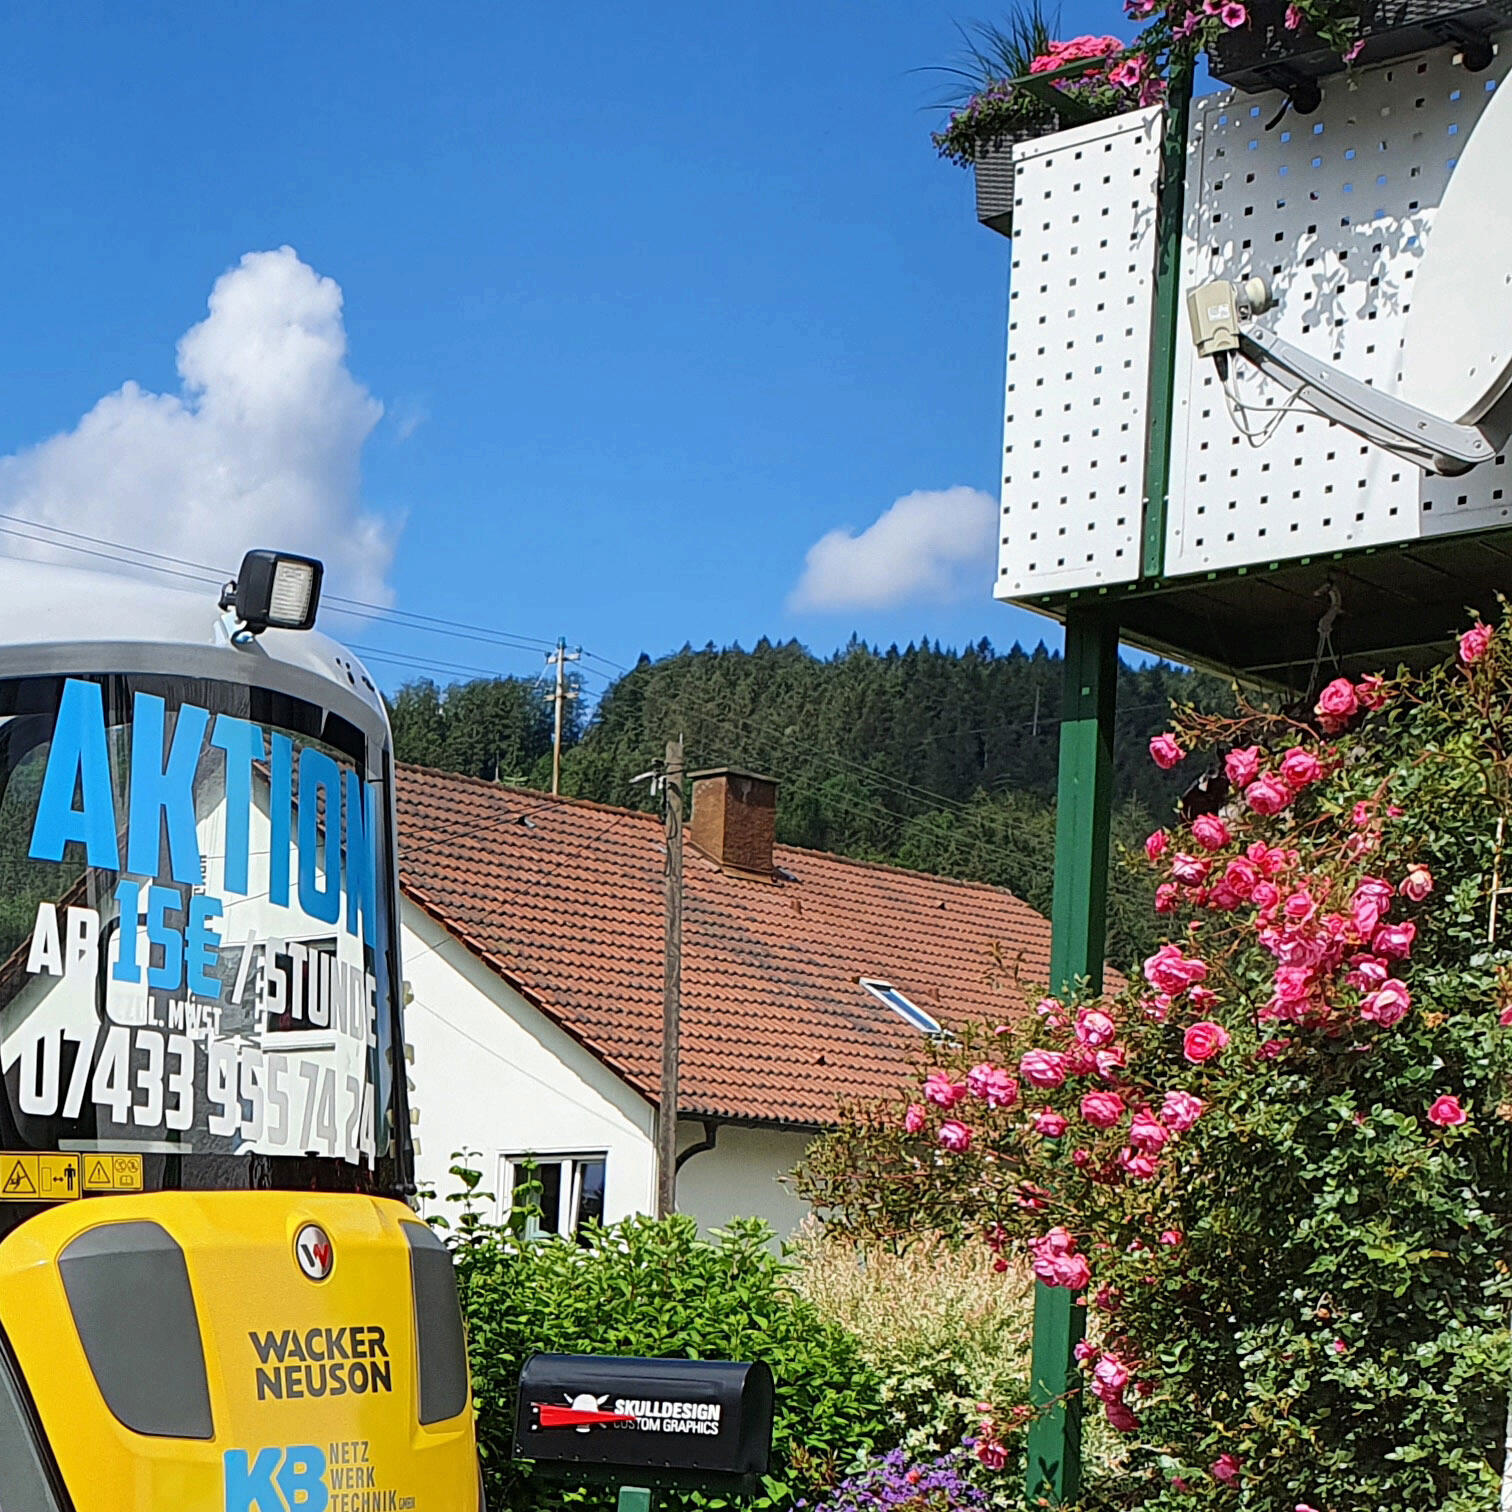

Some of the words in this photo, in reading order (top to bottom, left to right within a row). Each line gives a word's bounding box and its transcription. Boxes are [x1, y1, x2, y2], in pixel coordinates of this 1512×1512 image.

[28, 678, 376, 949] AKTION
[26, 902, 100, 980] AB
[265, 937, 376, 1048] STUNDE
[168, 998, 224, 1035] MWST
[19, 1019, 195, 1131] 07433
[207, 1040, 288, 1146] 955
[299, 1060, 337, 1155] 74
[345, 1074, 376, 1171] 24
[248, 1325, 389, 1364] WACKER
[255, 1360, 392, 1400] NEUSON
[614, 1398, 721, 1421] SKULLDESIGN
[663, 1418, 719, 1435] GRAPHICS
[330, 1441, 369, 1464] NETZ
[330, 1466, 375, 1490] WERK
